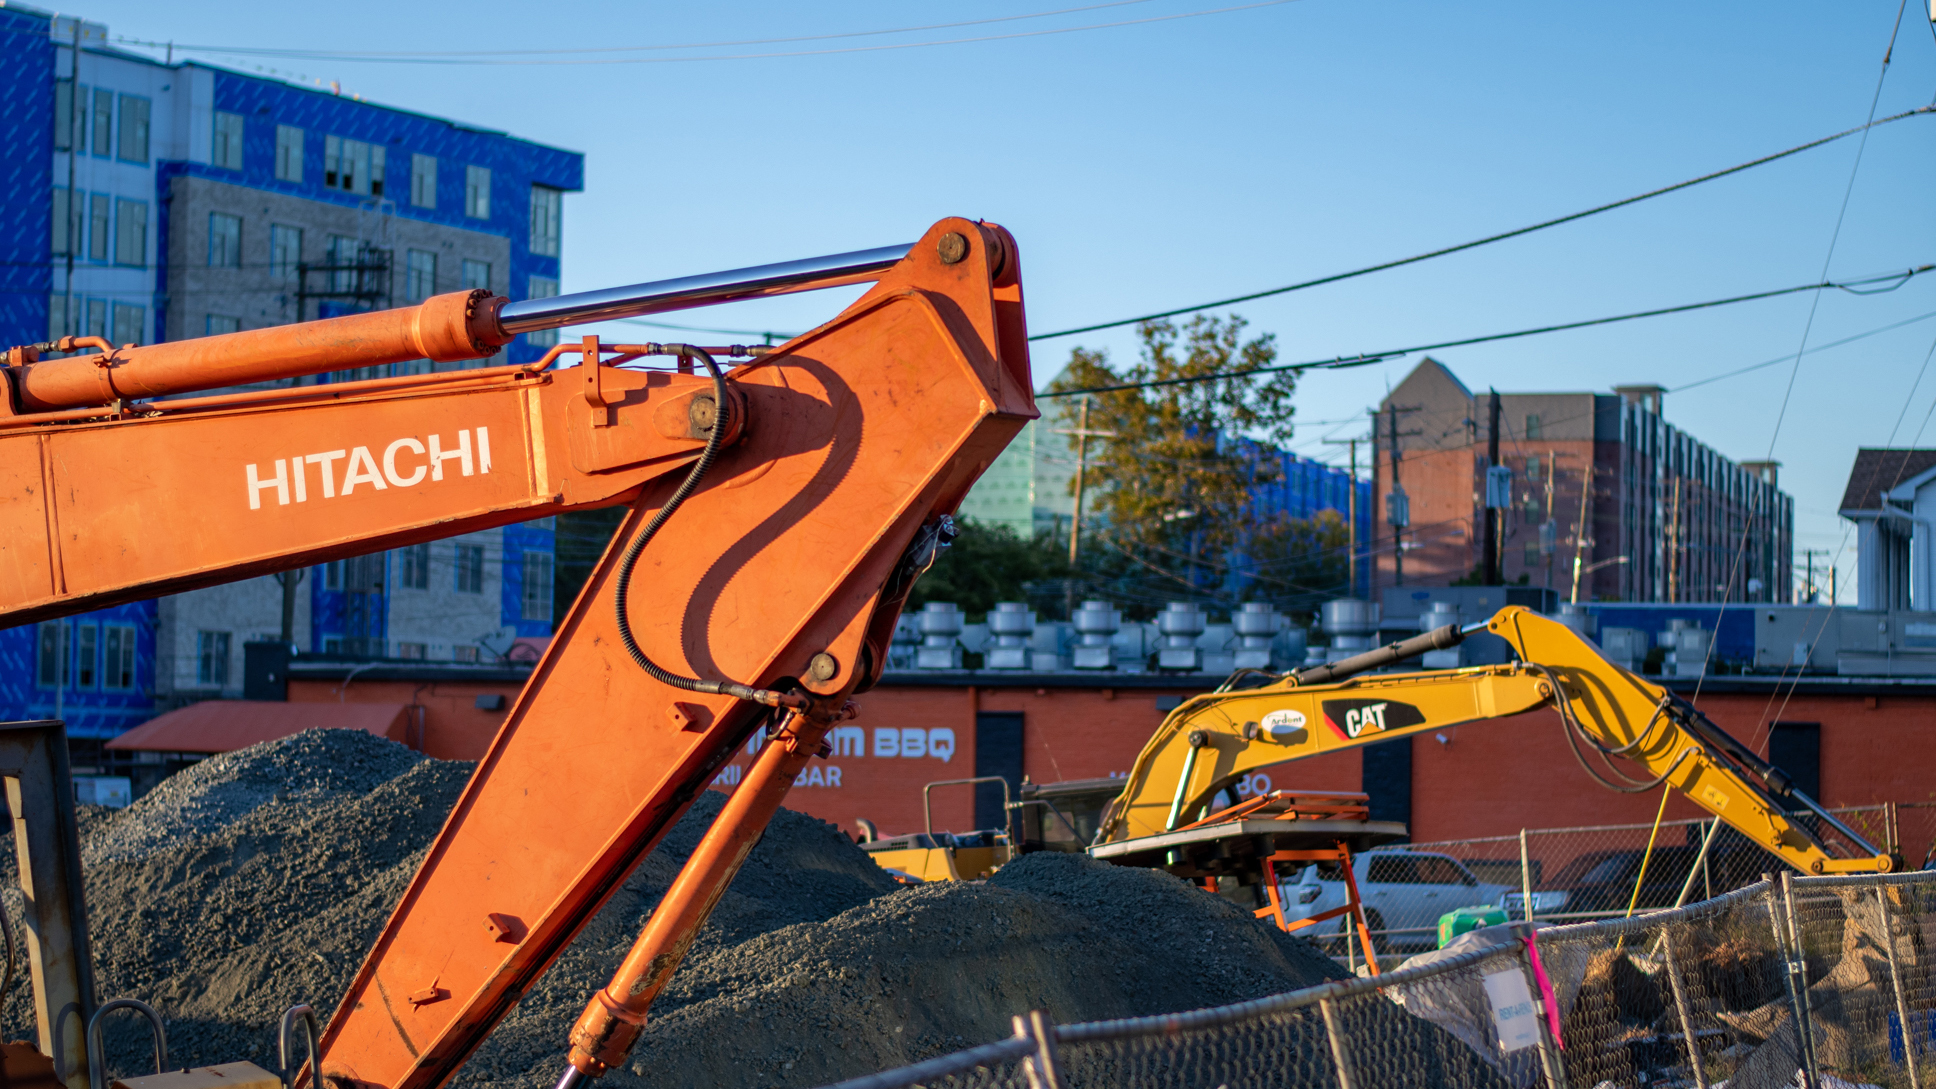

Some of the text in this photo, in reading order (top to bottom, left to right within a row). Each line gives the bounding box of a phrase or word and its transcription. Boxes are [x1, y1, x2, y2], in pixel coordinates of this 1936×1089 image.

[246, 426, 492, 510] HITACHI
[1271, 713, 1302, 725] Ardent
[1345, 702, 1387, 738] CAT
[874, 728, 956, 762] BBQ
[794, 766, 842, 787] BAR
